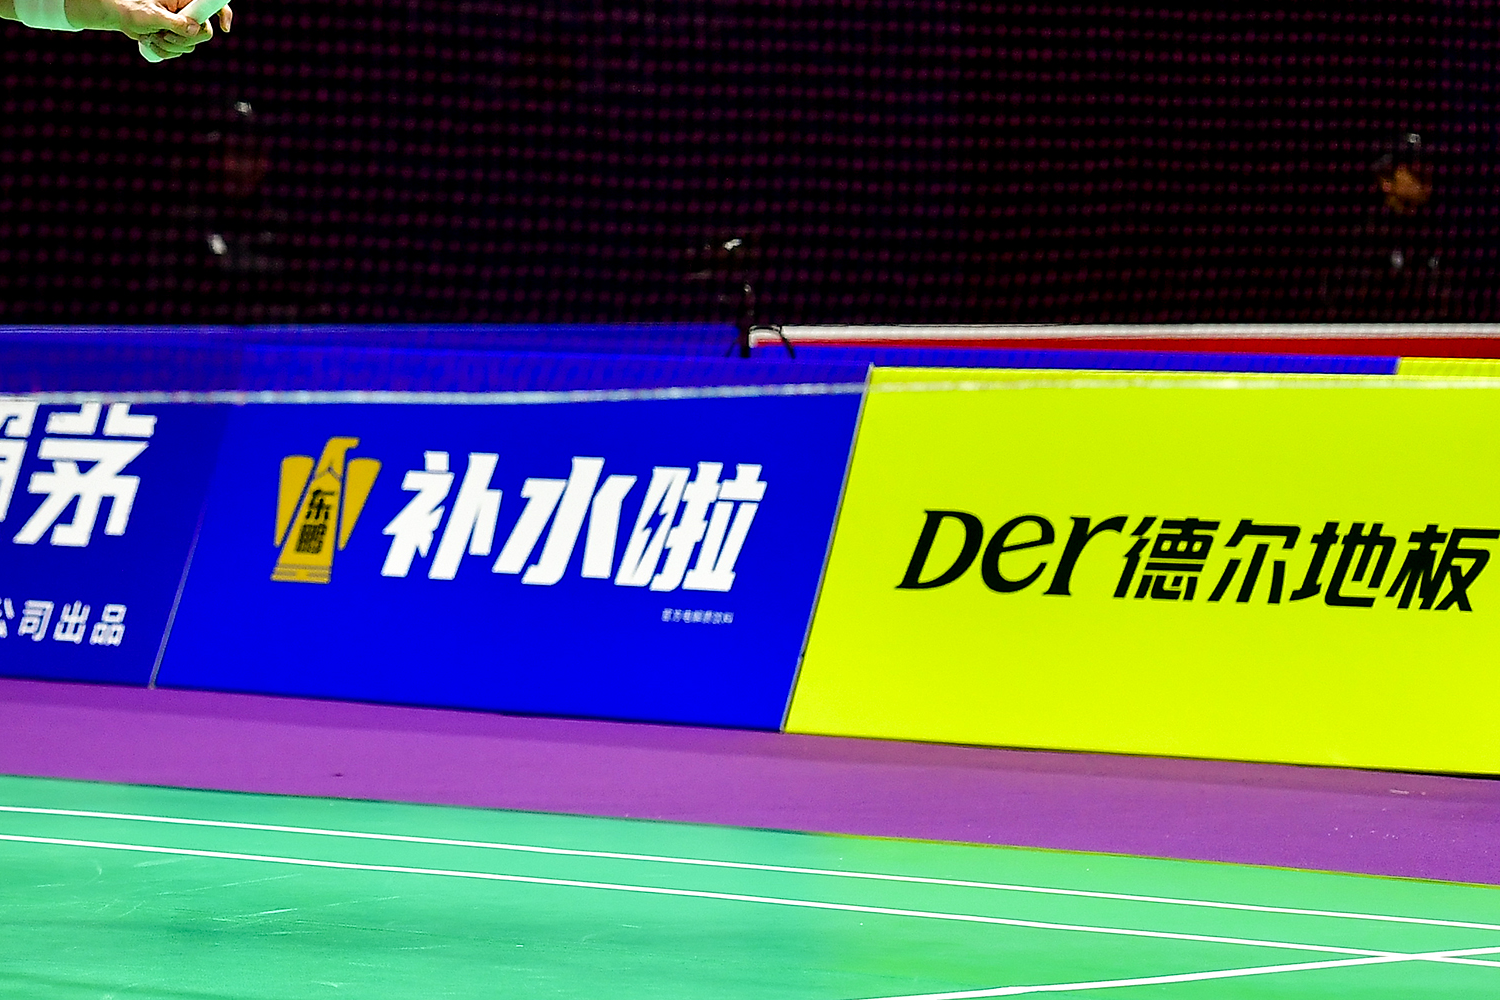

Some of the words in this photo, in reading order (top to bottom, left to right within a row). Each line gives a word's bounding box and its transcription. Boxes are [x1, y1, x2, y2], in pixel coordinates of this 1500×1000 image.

[380, 450, 768, 593] 补水啦
[1113, 515, 1500, 612] 德尔地板
